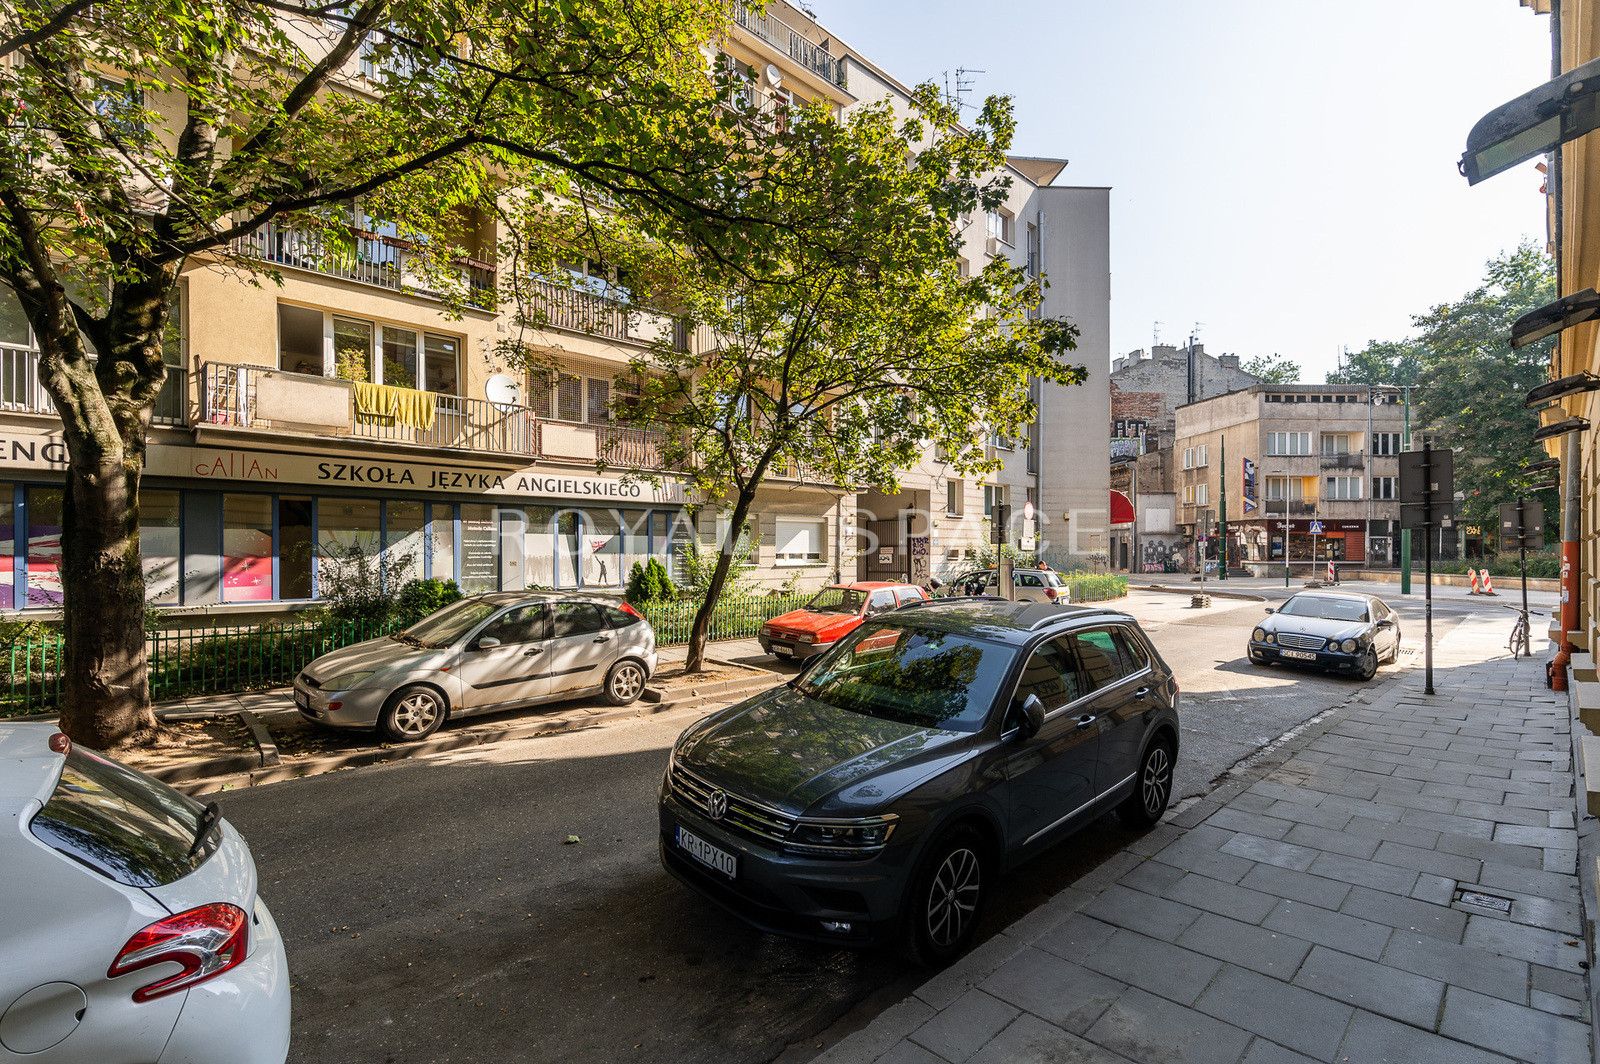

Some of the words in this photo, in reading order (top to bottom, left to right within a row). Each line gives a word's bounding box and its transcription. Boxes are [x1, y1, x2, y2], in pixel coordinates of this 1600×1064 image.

[317, 462, 415, 485] SZKOŁA
[427, 470, 505, 490] JĘZYKA
[516, 477, 641, 498] ANGIELSKIEGO
[681, 829, 694, 852] KR
[698, 840, 734, 875] 1PX10
